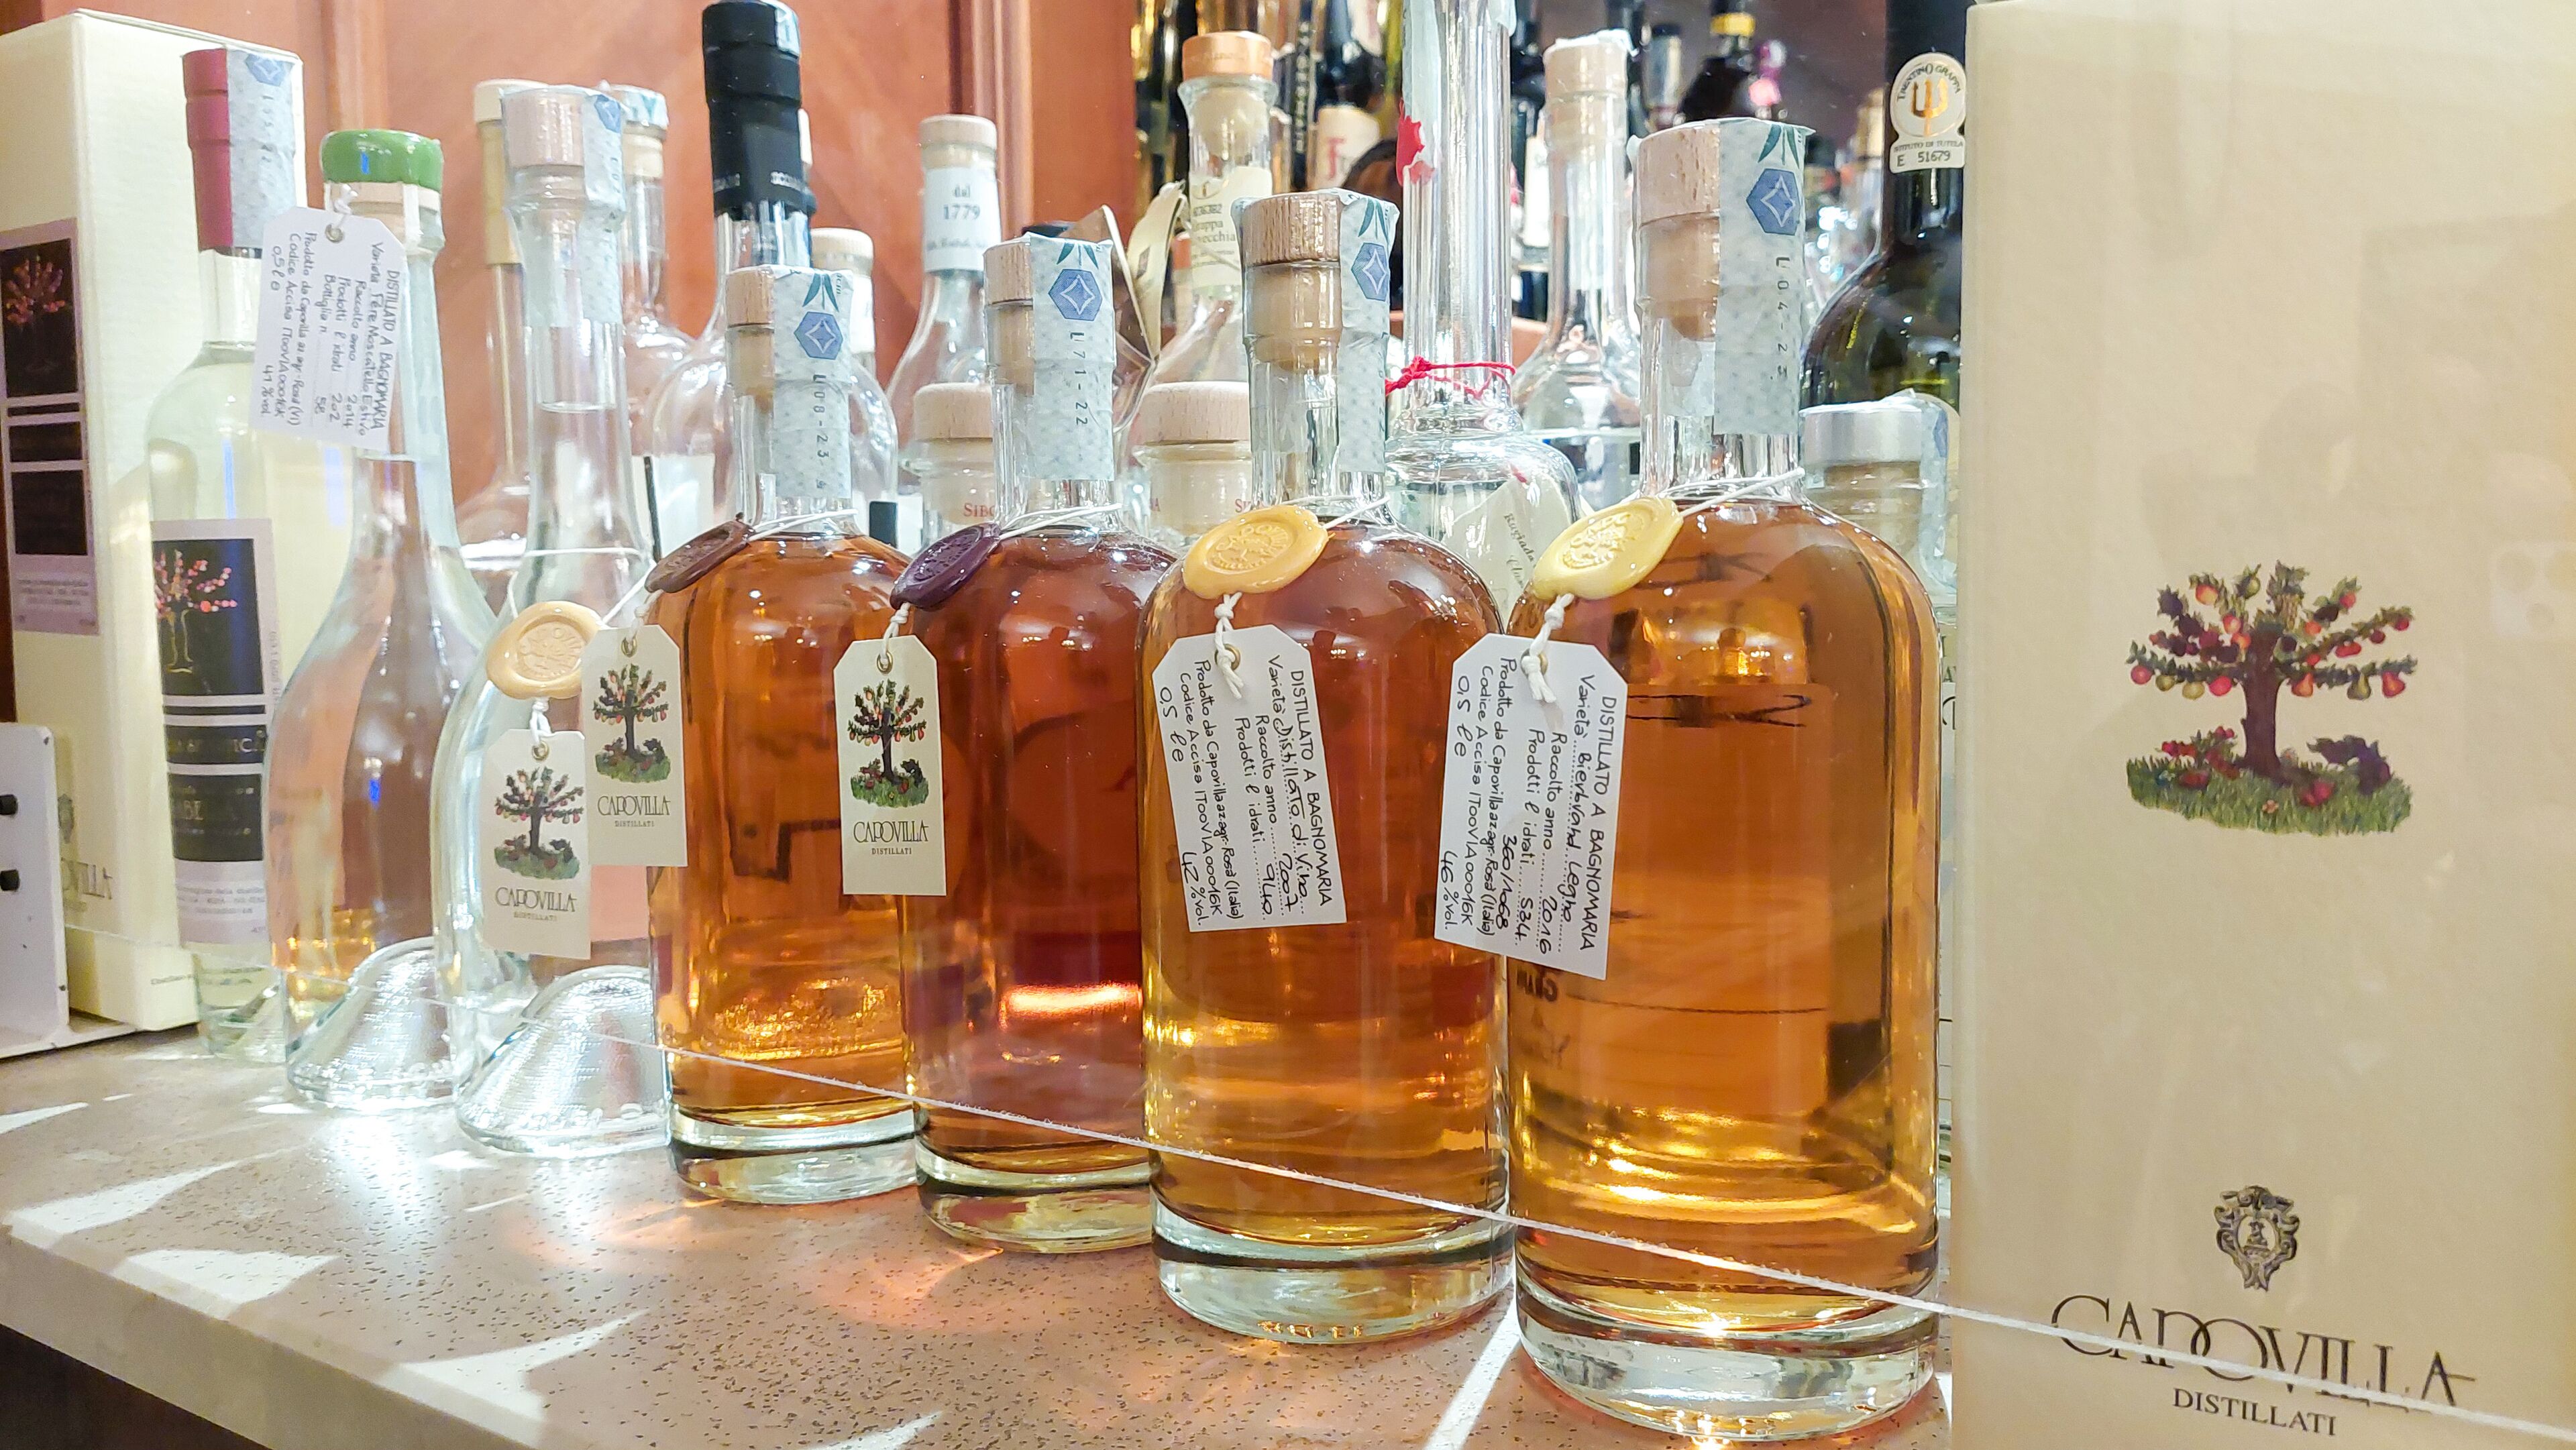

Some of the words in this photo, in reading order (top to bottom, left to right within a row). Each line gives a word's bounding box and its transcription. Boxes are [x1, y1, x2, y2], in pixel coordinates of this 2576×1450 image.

[1894, 142, 1924, 153] STITUTO
[1897, 154, 1905, 167] E
[1918, 150, 1951, 163] 51679
[943, 203, 980, 220] 1779
[954, 184, 971, 198] dal
[288, 233, 301, 276] Codice
[284, 280, 298, 321] Accisa
[301, 281, 312, 295] da
[335, 276, 352, 321] Prodotti
[383, 270, 400, 332] DISTILLATO
[349, 333, 359, 361] anno
[379, 336, 394, 345] A
[370, 352, 393, 430] BAGNOMARIA
[1070, 331, 1088, 426] L71-22
[329, 392, 343, 423] 202
[343, 394, 358, 429] 2014
[812, 374, 830, 459] L08-23
[1180, 673, 1195, 724] Codice
[1194, 659, 1215, 716] Prodotto
[1456, 675, 1471, 712] 0,5
[1477, 665, 1494, 722] Codice
[1495, 657, 1517, 718] Prodotto
[1574, 674, 1596, 738] Varietà
[1202, 720, 1217, 737] da
[1291, 670, 1314, 761] DISTILLATO
[1493, 721, 1508, 740] da
[1187, 729, 1203, 783] Accisa
[1255, 714, 1277, 779] Raccolto
[1268, 655, 1286, 714] Varietà
[1291, 824, 1309, 846] di
[1472, 725, 1489, 785] Accisa
[1526, 728, 1546, 794] Prodotti
[1546, 732, 1568, 802] Raccolto
[1594, 696, 1617, 795] DISTILLATO
[1160, 687, 1178, 718] 0,5
[1181, 851, 1199, 884] 42
[1205, 741, 1227, 803] Capovilla
[1303, 769, 1318, 782] A
[1487, 744, 1506, 810] Capovilla
[597, 795, 672, 816] CAPOVILLA
[614, 820, 655, 828] DISTILLATI
[1234, 717, 1256, 777] Prodotti
[1248, 803, 1265, 843] idrati
[1262, 862, 1276, 915] 940
[1265, 785, 1277, 824] anno
[1591, 803, 1606, 817] A
[853, 819, 929, 844] CAPOVILLA
[871, 847, 912, 856] DISTILLATI
[1307, 792, 1333, 907] BAGNOMARIA
[1519, 822, 1537, 865] idrati
[1543, 807, 1555, 850] anno
[1279, 852, 1299, 912] 2007
[1441, 850, 1458, 884] 46
[1495, 834, 1517, 930] 360/1068
[1580, 830, 1605, 950] BAGNOMARIA
[495, 886, 578, 912] CAPOVILLA
[1224, 880, 1244, 919] (Italia)
[1477, 893, 1497, 936] (Italia)
[1540, 896, 1558, 954] 2016
[2050, 1294, 2478, 1414] CAPOVILLA
[2172, 1387, 2339, 1437] DISTILLATI
